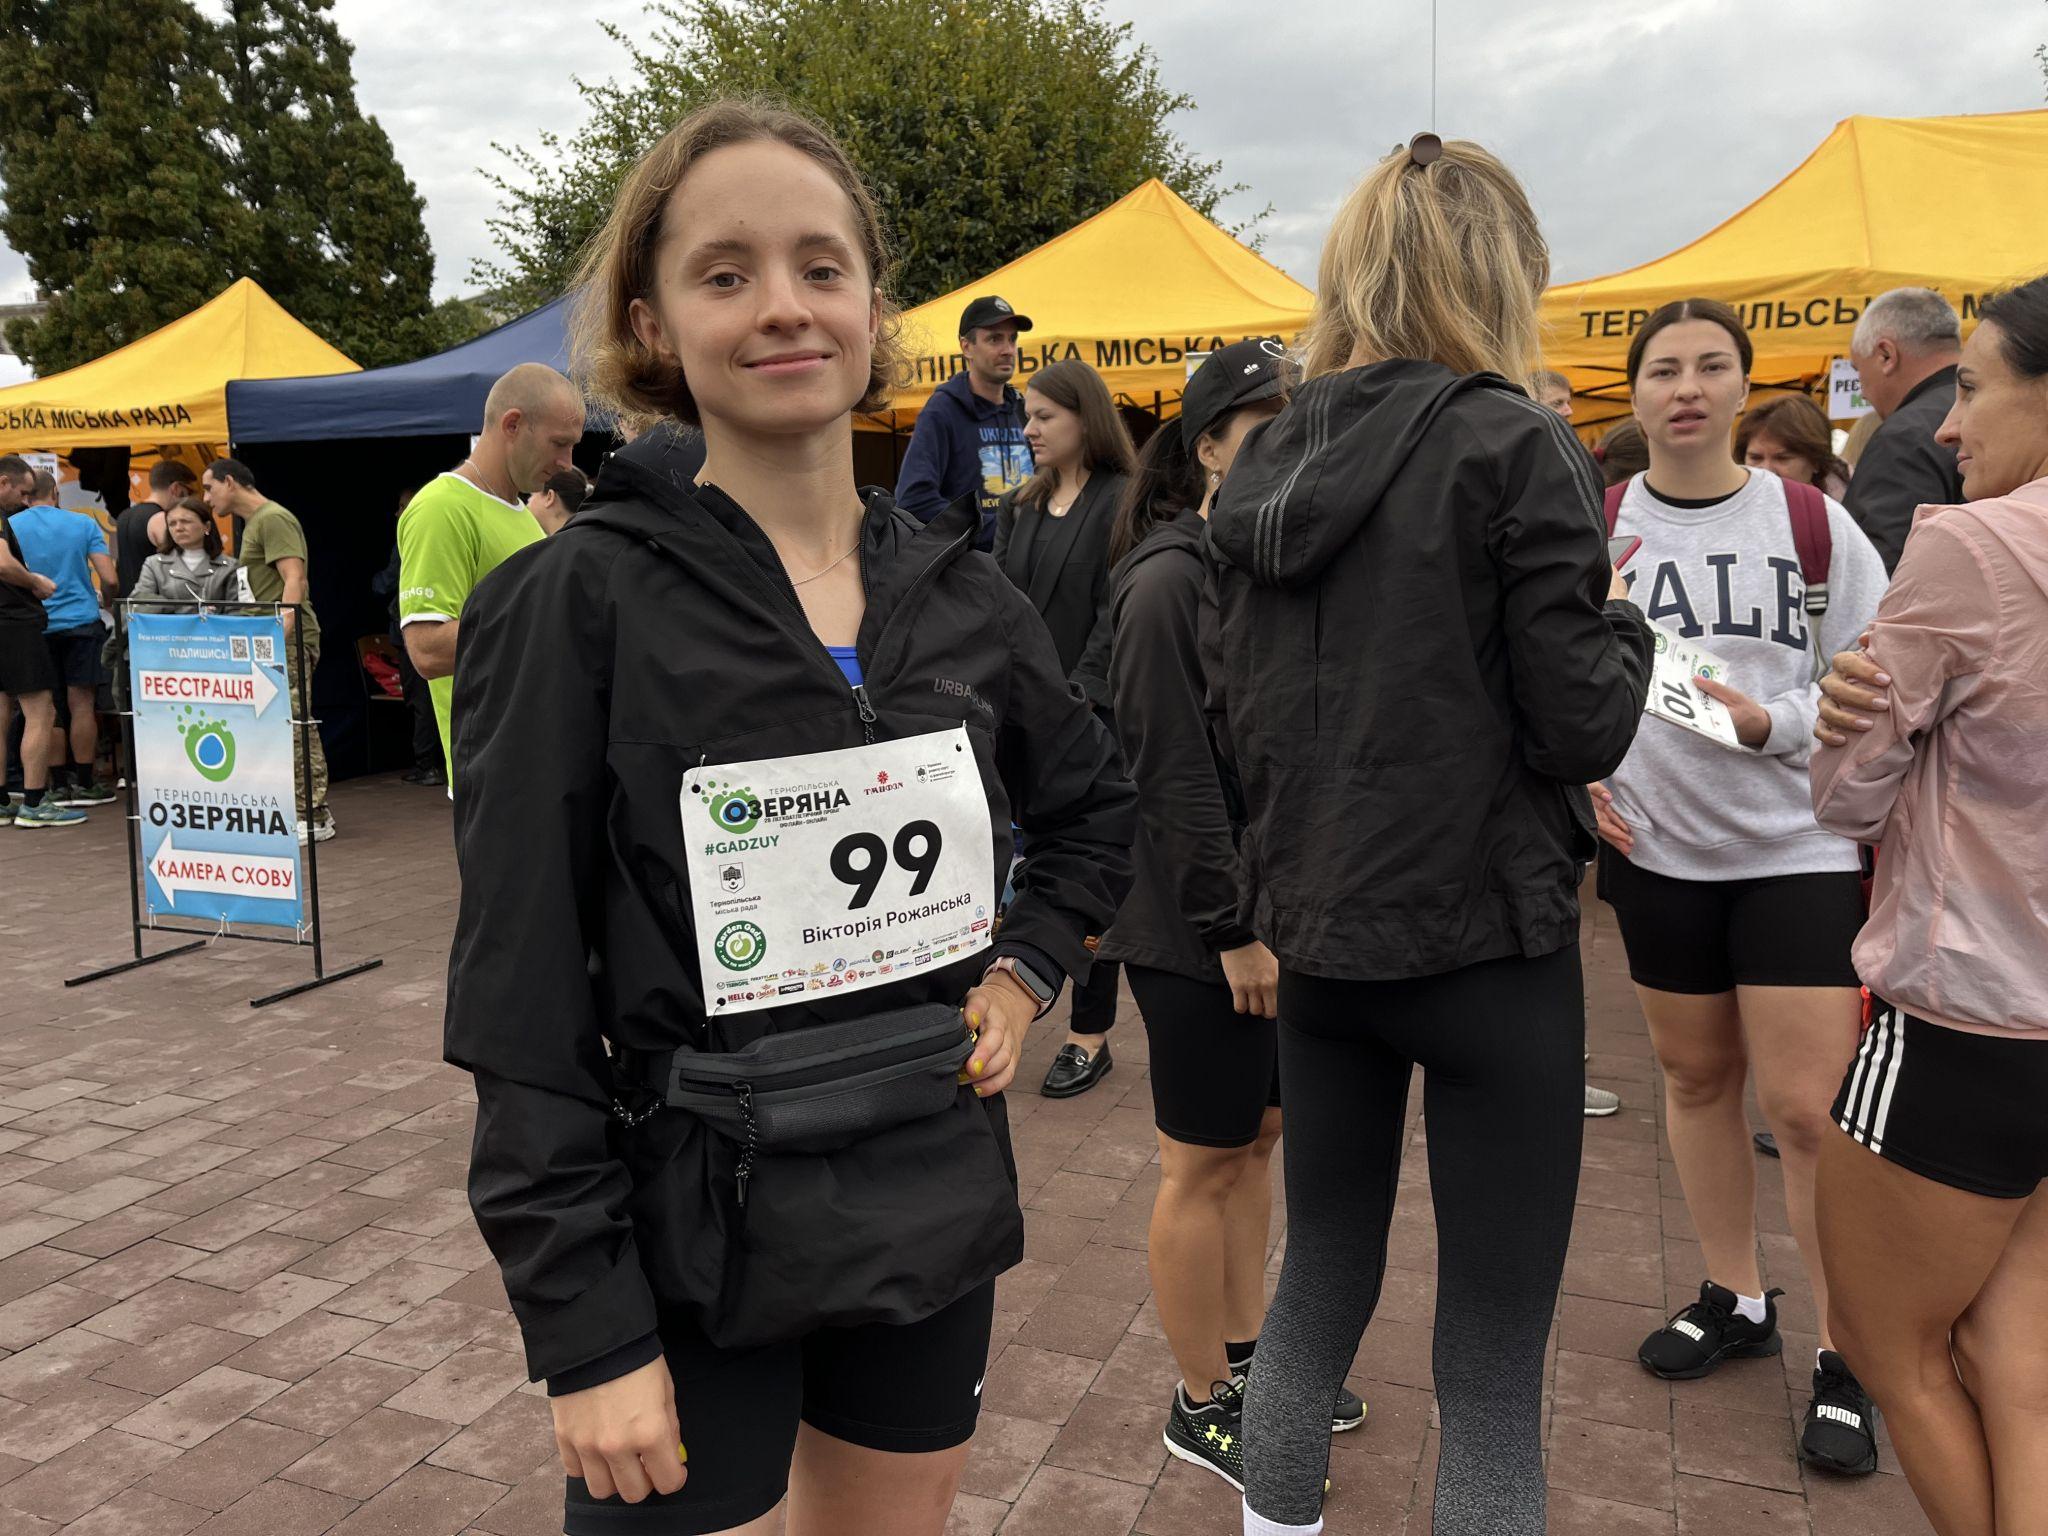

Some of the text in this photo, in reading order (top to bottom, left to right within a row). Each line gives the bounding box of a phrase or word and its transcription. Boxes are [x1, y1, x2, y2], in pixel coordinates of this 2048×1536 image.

[50, 408, 130, 429] МІСЬКА
[130, 403, 192, 428] РАДА
[1625, 552, 1808, 652] ALE
[169, 647, 228, 660] ПІДПИШИСЬ
[144, 676, 254, 701] РЕЄСТРАЦІЯ
[154, 788, 279, 808] ТЕРНОПІЛЬСЬКА
[768, 780, 840, 795] ТЕРНОПІЛЬСЬКА
[723, 788, 851, 824] ОЗЕРЯНА
[149, 802, 289, 836] ОЗЕРЯНА
[705, 835, 780, 856] #GADZUY
[157, 859, 293, 888] КАМЕРА СХОВУ
[830, 820, 942, 910] 99
[710, 895, 762, 909] Тернопільська
[715, 903, 758, 916] міська рада
[802, 916, 882, 945] Вікторія
[886, 892, 972, 927] Рожанська
[717, 923, 763, 948] Garden Gadz
[1671, 1319, 1705, 1342] PUMA
[1816, 1404, 1861, 1429] PUMA
